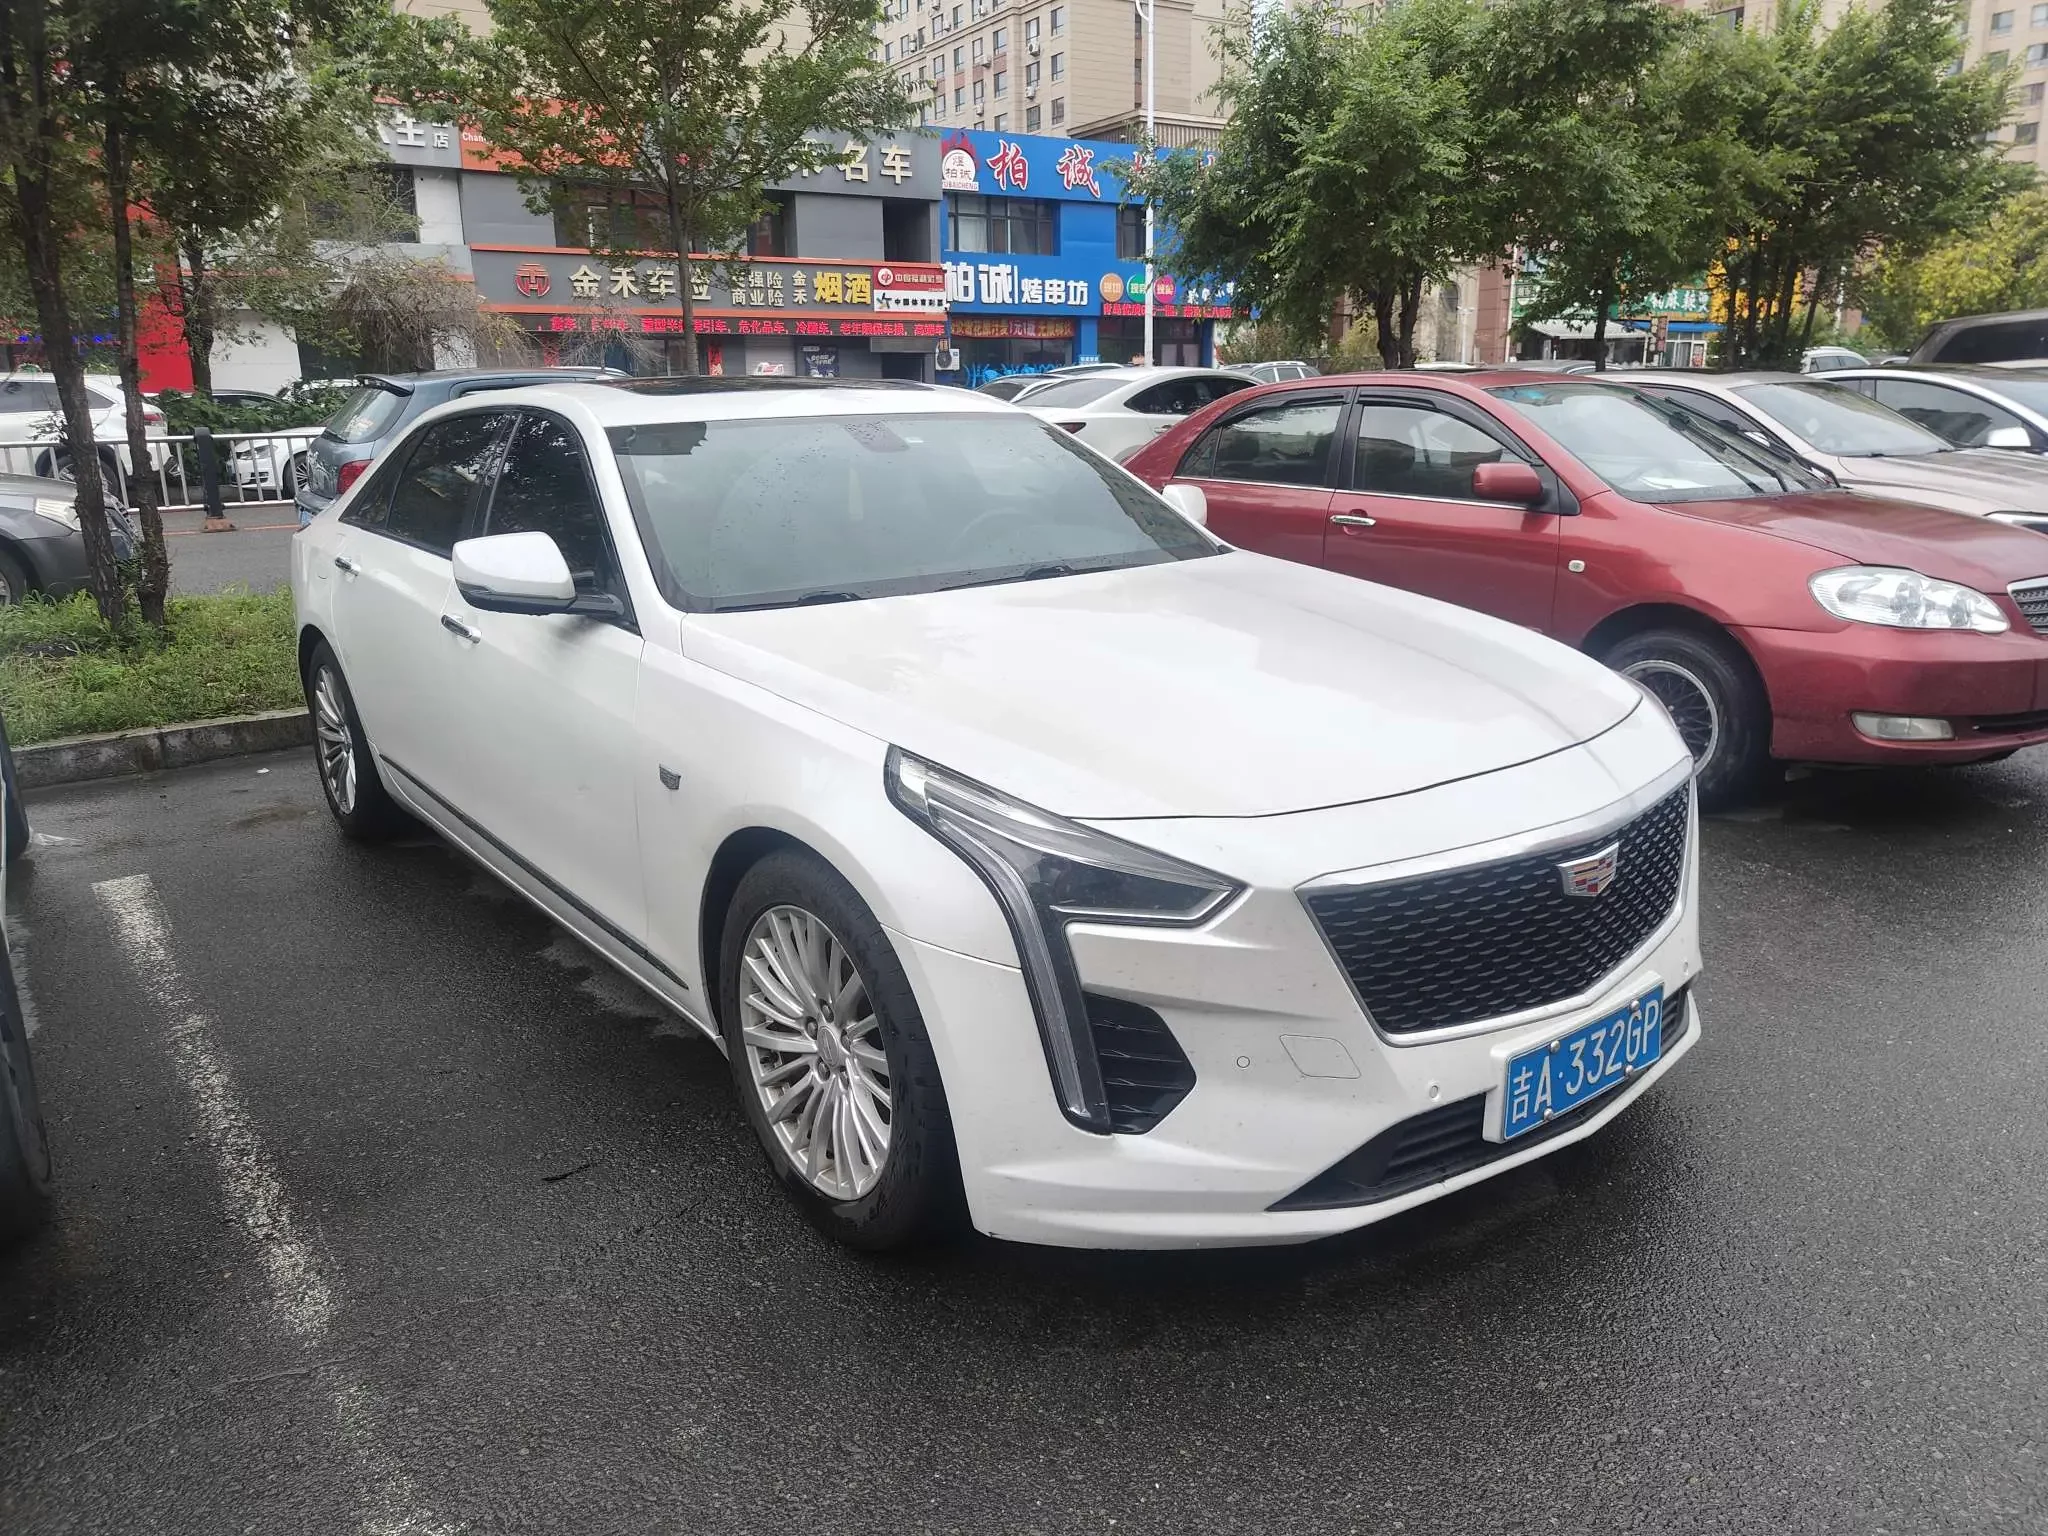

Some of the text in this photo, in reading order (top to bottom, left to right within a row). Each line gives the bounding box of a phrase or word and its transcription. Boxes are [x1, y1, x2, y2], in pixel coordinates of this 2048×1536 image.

[731, 287, 785, 307] 商业险
[812, 270, 872, 305] 烟酒
[942, 261, 1089, 306] 柏诚 烤串坊
